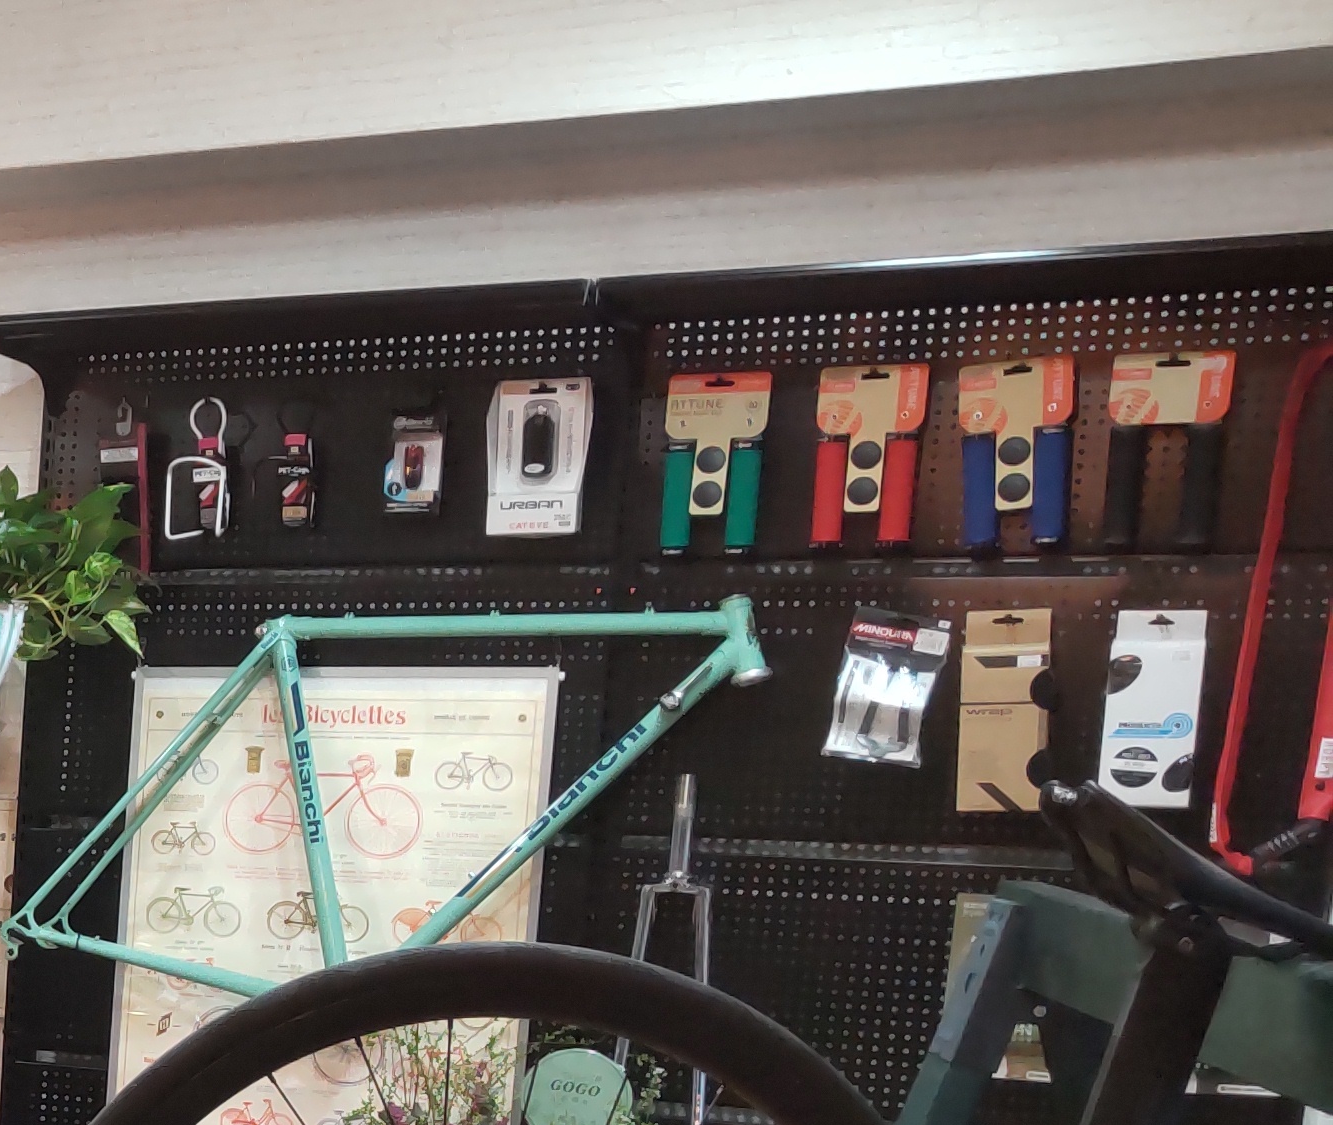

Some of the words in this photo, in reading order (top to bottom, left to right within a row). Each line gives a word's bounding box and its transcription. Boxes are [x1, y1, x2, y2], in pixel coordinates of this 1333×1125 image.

[500, 500, 563, 510] URBAN
[852, 623, 914, 641] MINOURA
[965, 708, 1013, 716] wrap
[293, 740, 324, 846] Bianchi
[515, 723, 647, 853] Bianchi
[550, 1079, 601, 1097] GOGO
